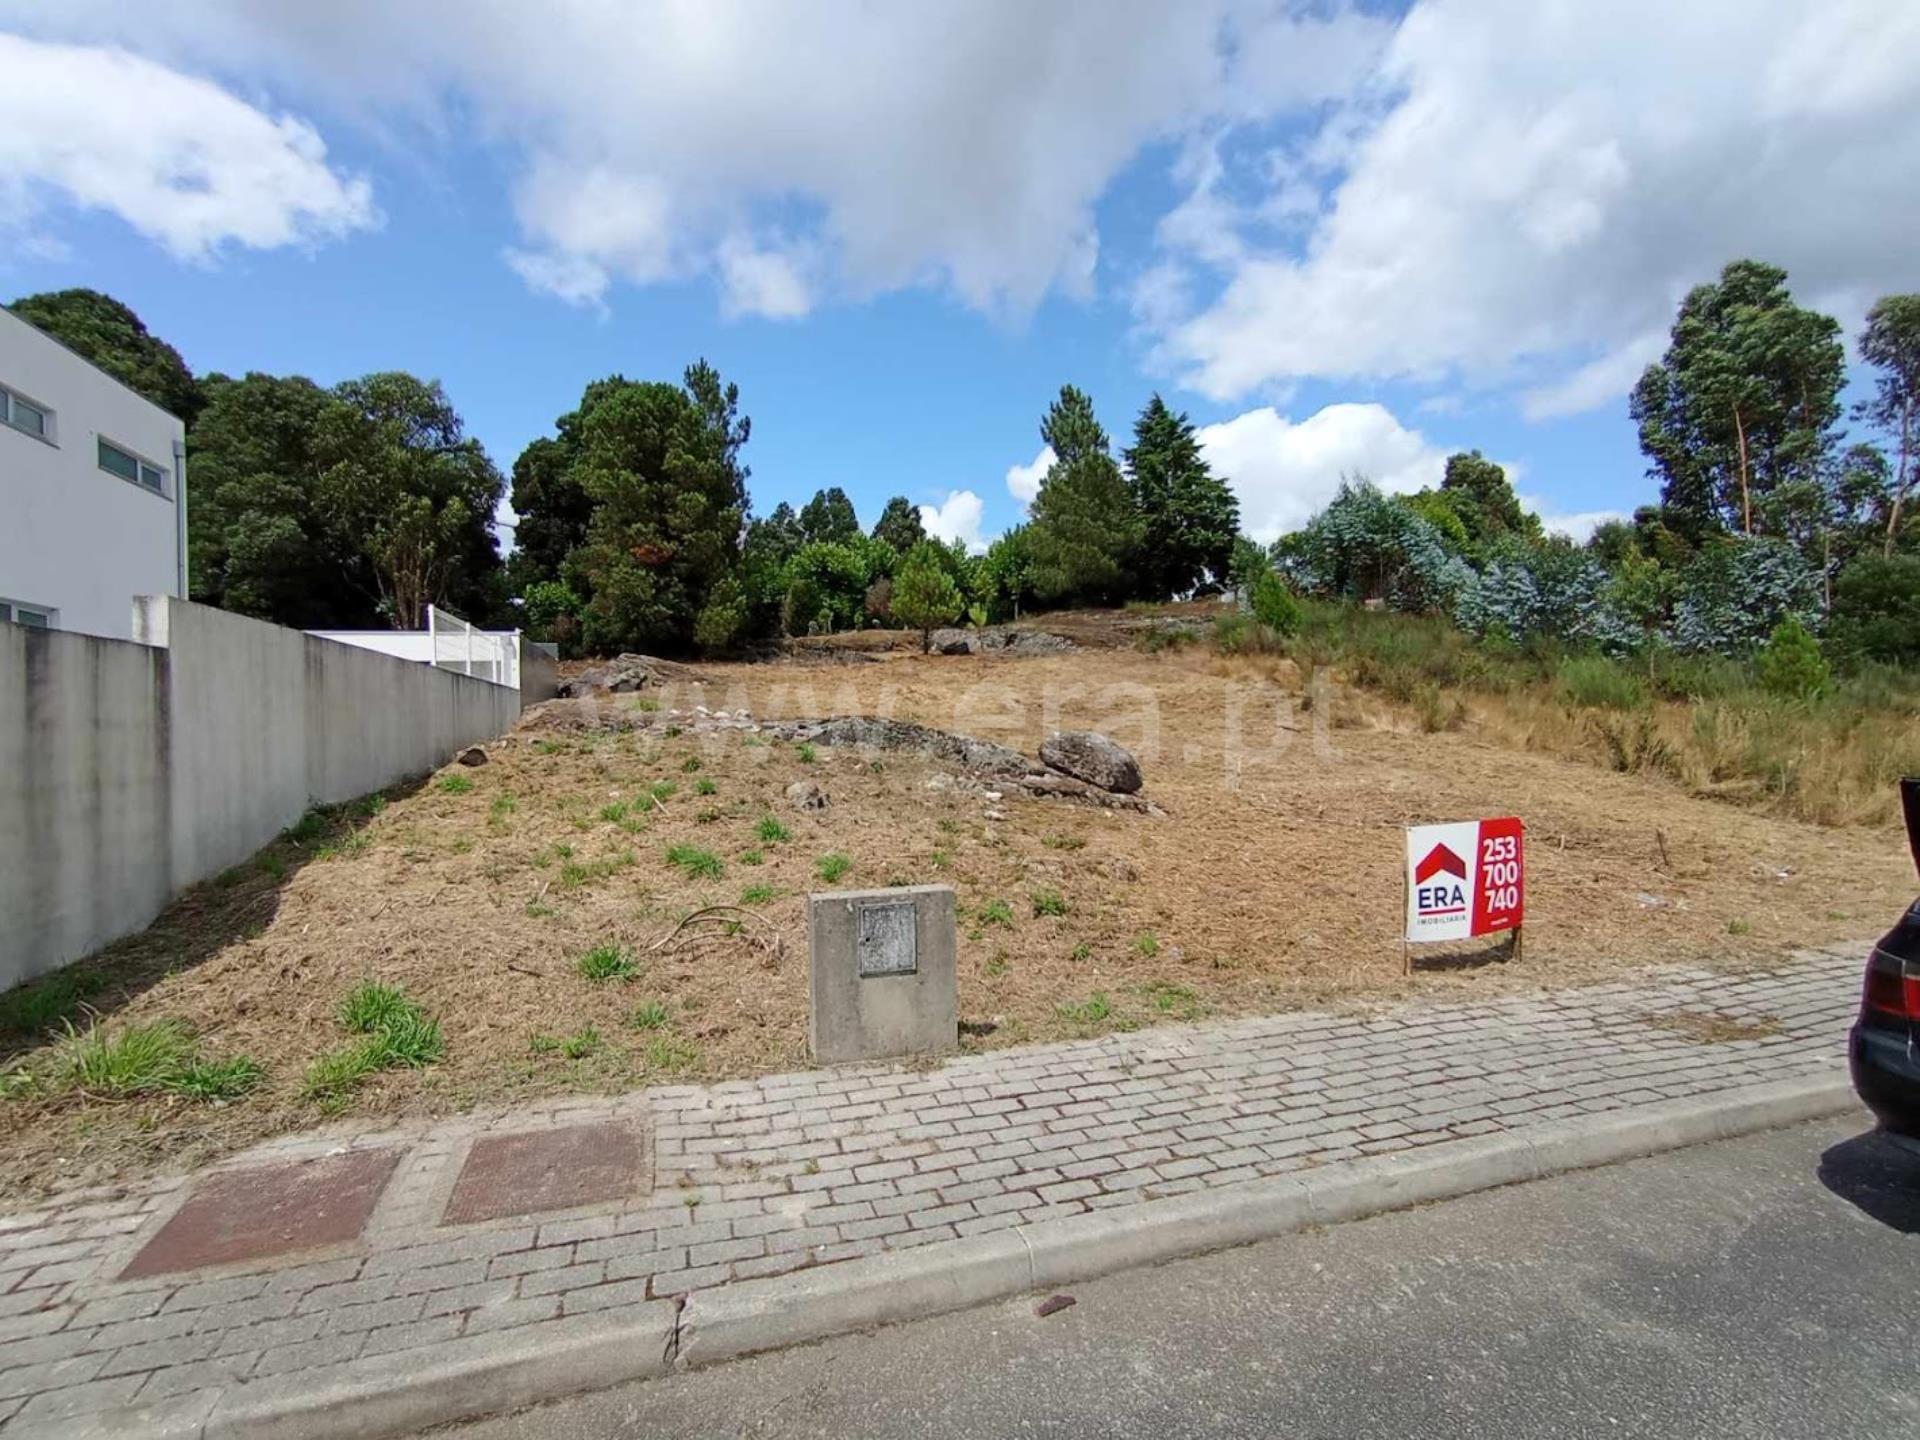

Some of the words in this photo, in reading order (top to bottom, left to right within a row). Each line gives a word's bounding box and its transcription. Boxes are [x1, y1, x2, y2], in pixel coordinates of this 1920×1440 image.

[1483, 836, 1516, 863] 253
[1483, 861, 1518, 889] 700
[1418, 885, 1465, 909] ERA
[1485, 886, 1518, 914] 740
